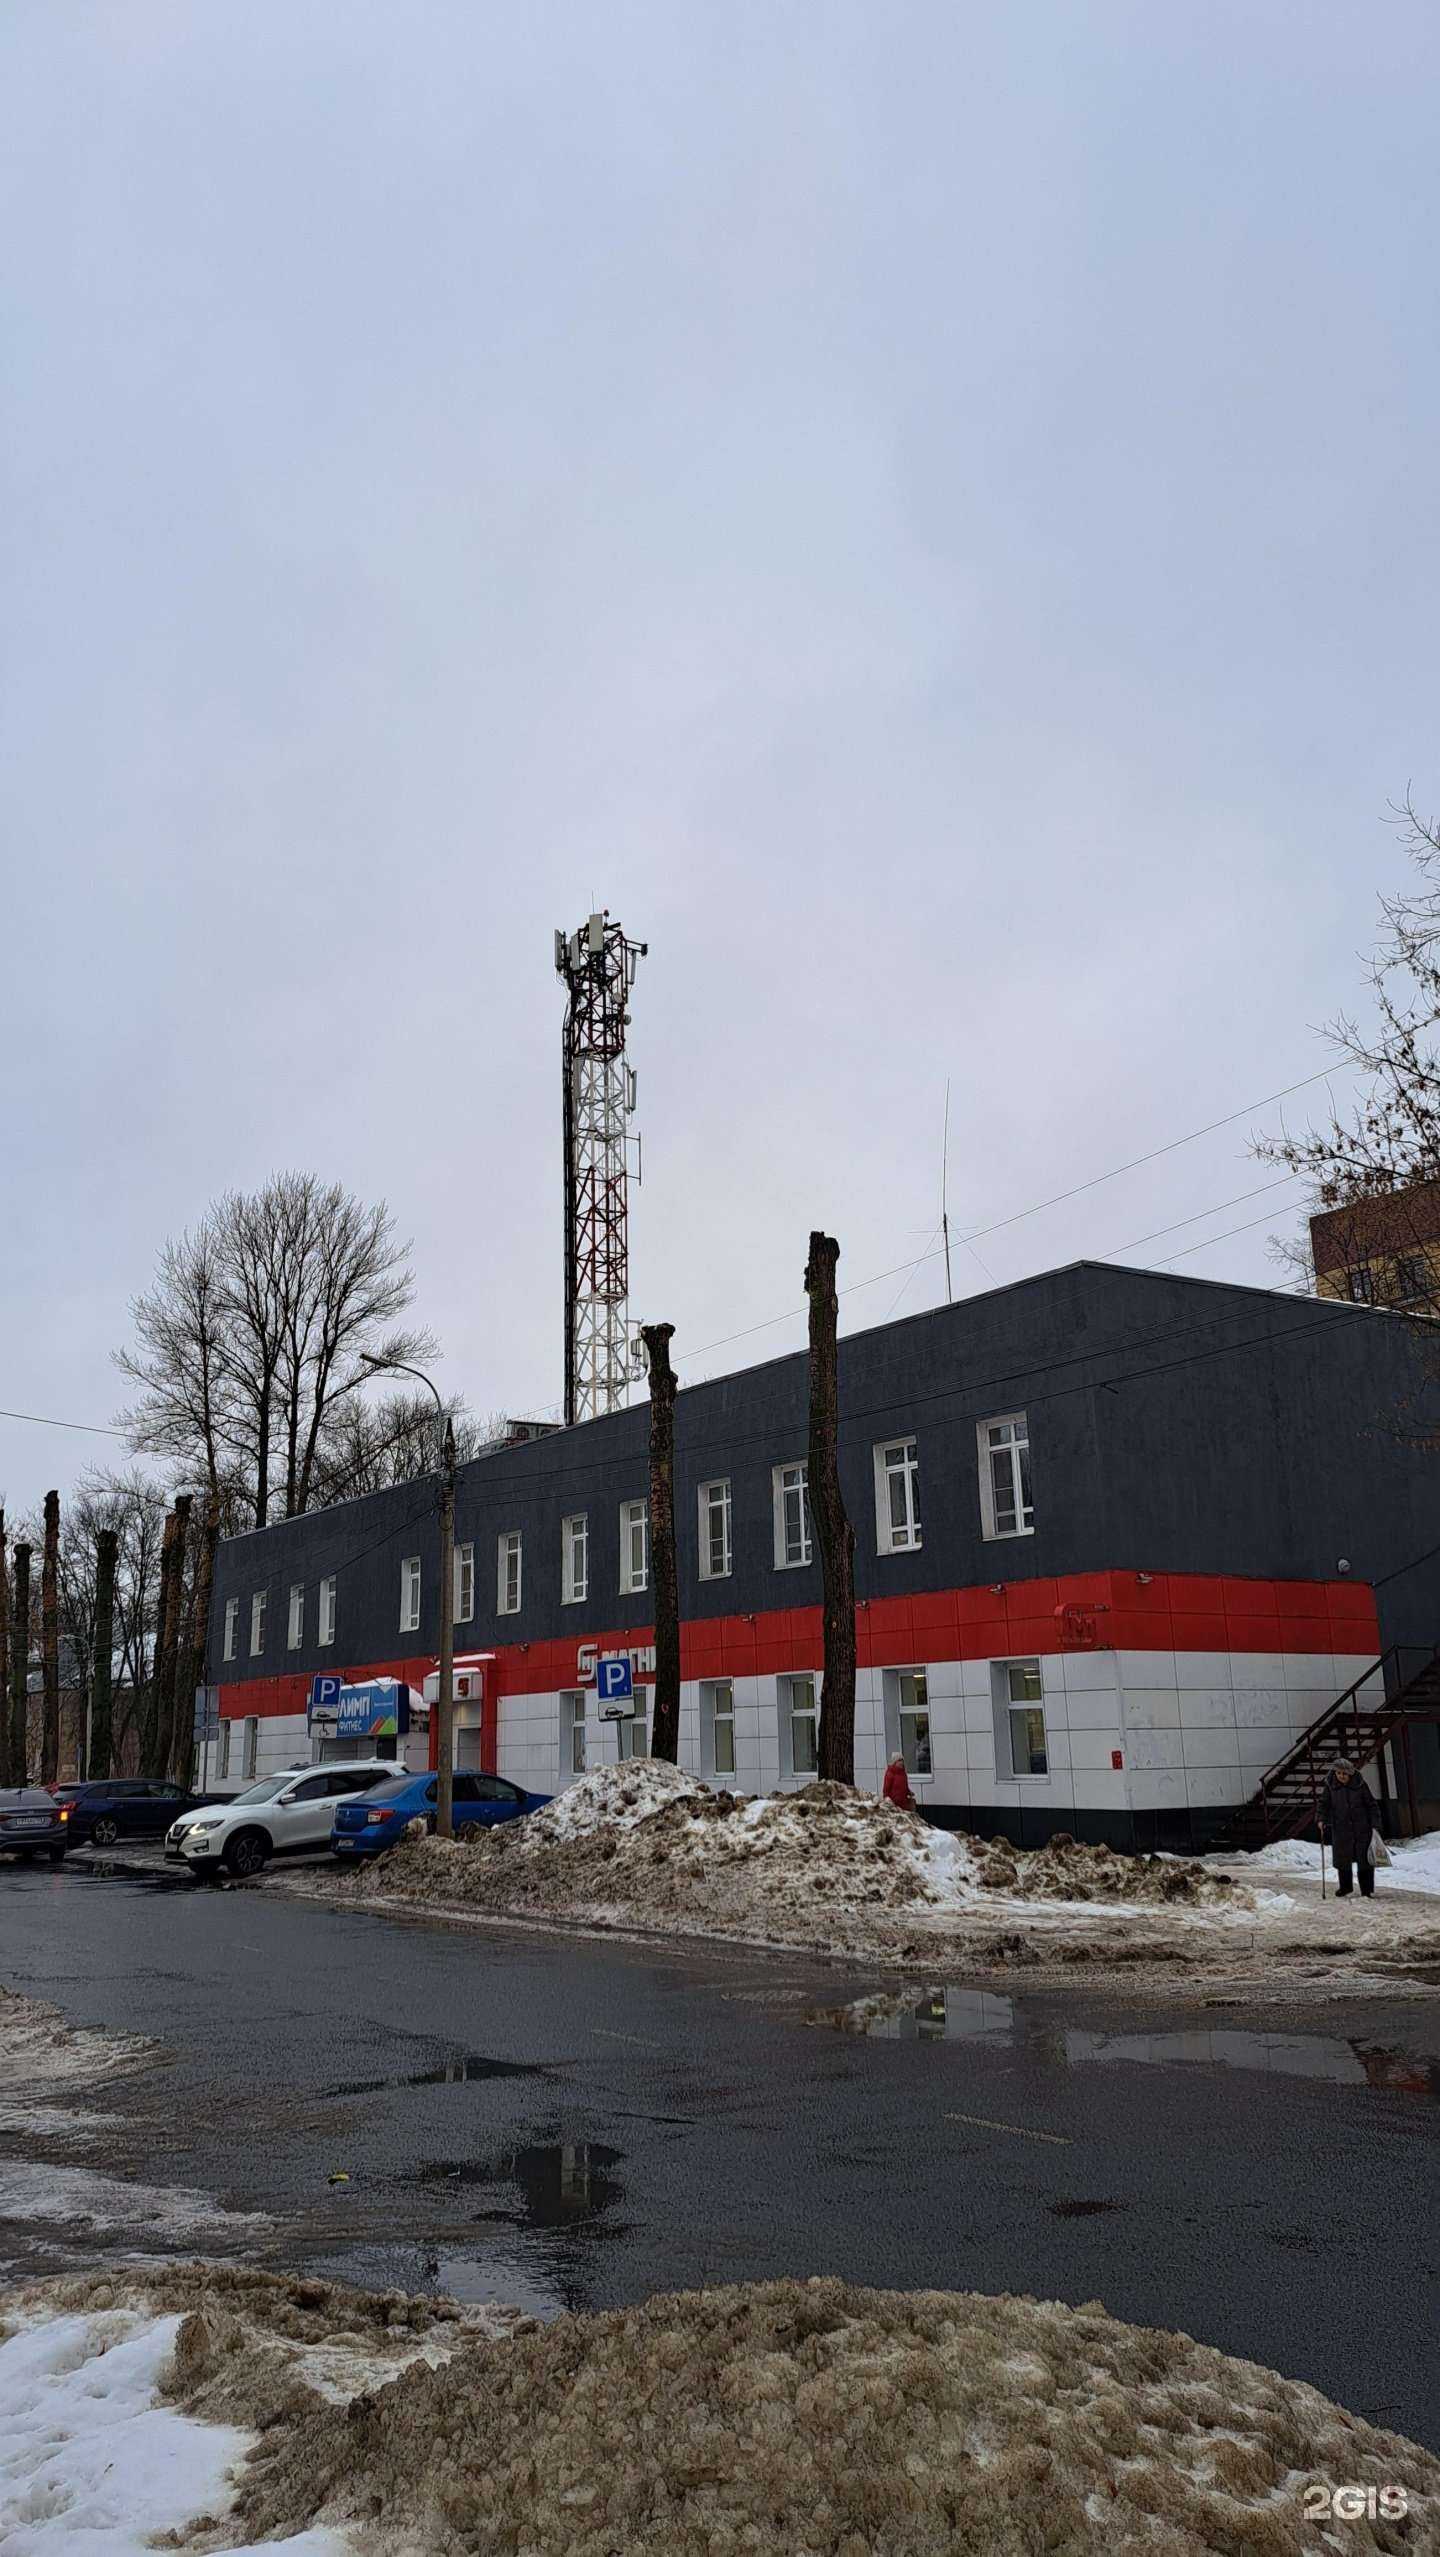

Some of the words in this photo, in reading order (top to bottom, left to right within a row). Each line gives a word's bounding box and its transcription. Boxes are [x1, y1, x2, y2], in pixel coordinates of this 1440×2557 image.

[320, 1679, 336, 1702] P
[606, 1663, 625, 1695] P
[338, 1695, 370, 1718] ЛИМП
